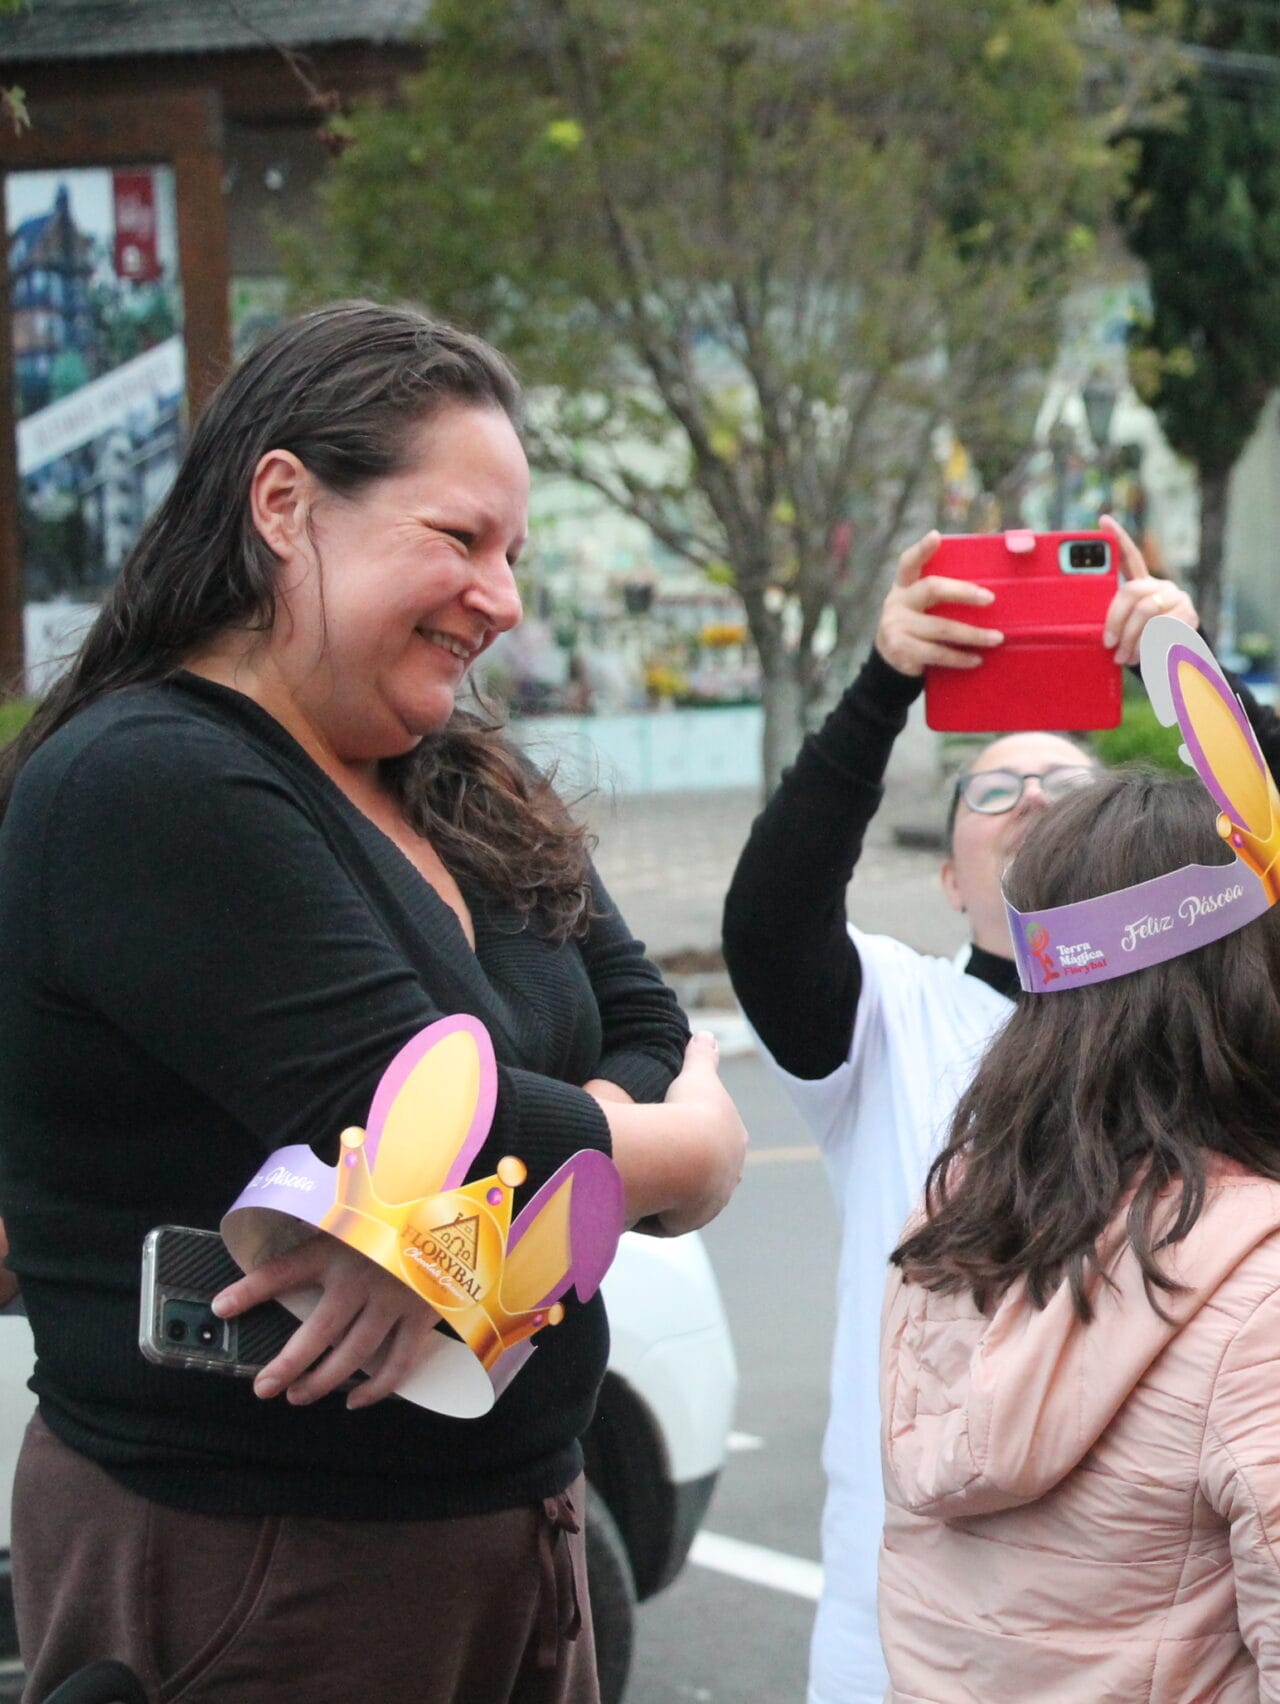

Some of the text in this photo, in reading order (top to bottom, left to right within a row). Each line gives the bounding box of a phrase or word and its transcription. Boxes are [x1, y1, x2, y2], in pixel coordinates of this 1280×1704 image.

[1120, 883, 1244, 952] Feliz Páscoa
[1056, 942, 1091, 956] Terra
[1059, 950, 1105, 967] Mágica
[401, 1223, 482, 1303] FLORYBAL
